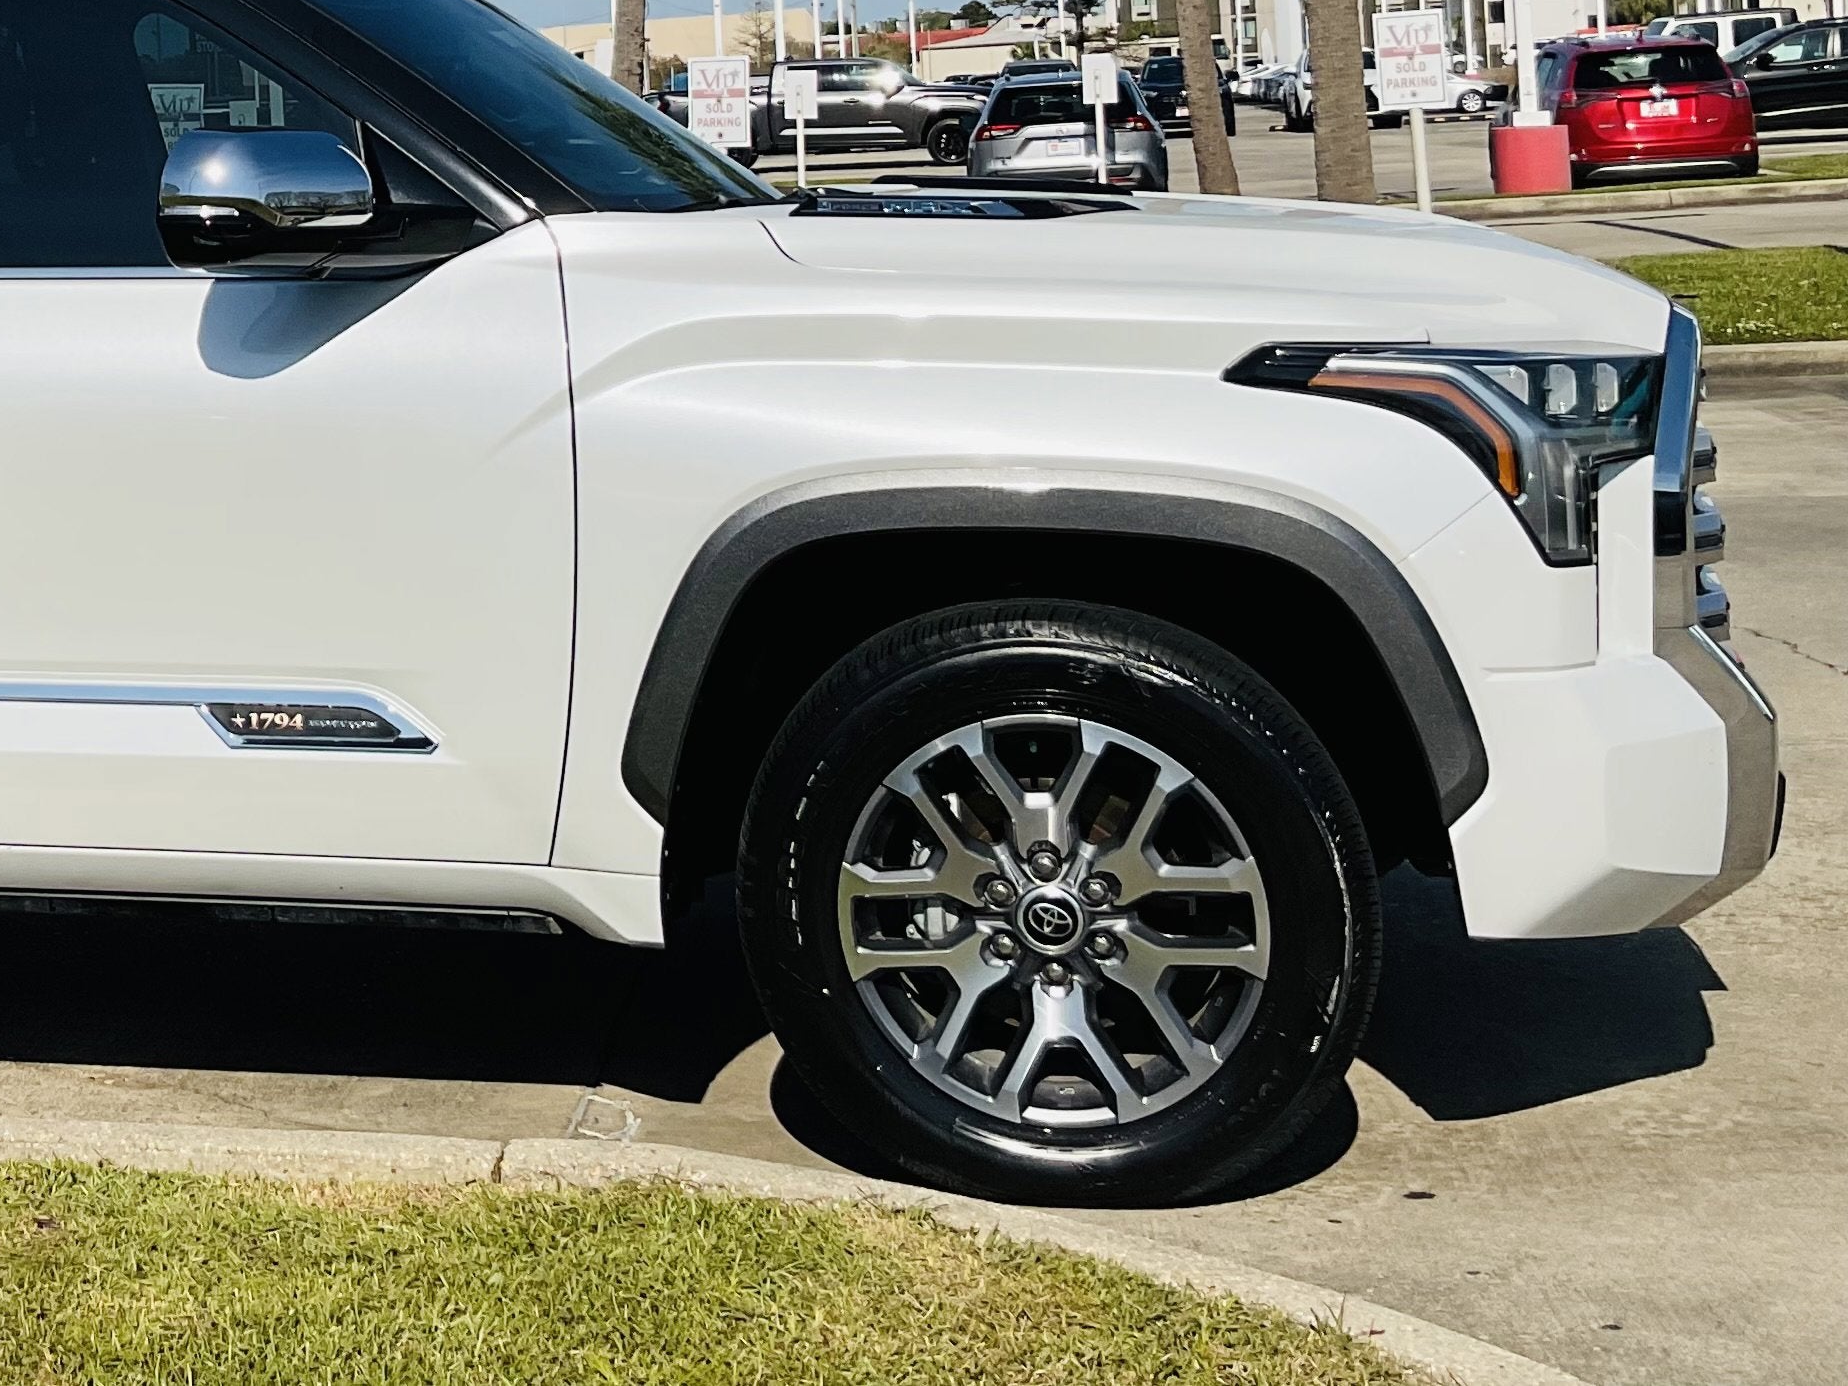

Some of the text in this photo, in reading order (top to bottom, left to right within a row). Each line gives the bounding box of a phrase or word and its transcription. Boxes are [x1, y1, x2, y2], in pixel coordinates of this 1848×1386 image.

[1395, 61, 1426, 73] SOLD
[1386, 76, 1438, 89] PARKING
[705, 102, 733, 114] SOLD
[696, 116, 742, 128] PARKING
[248, 711, 304, 731] 1794
